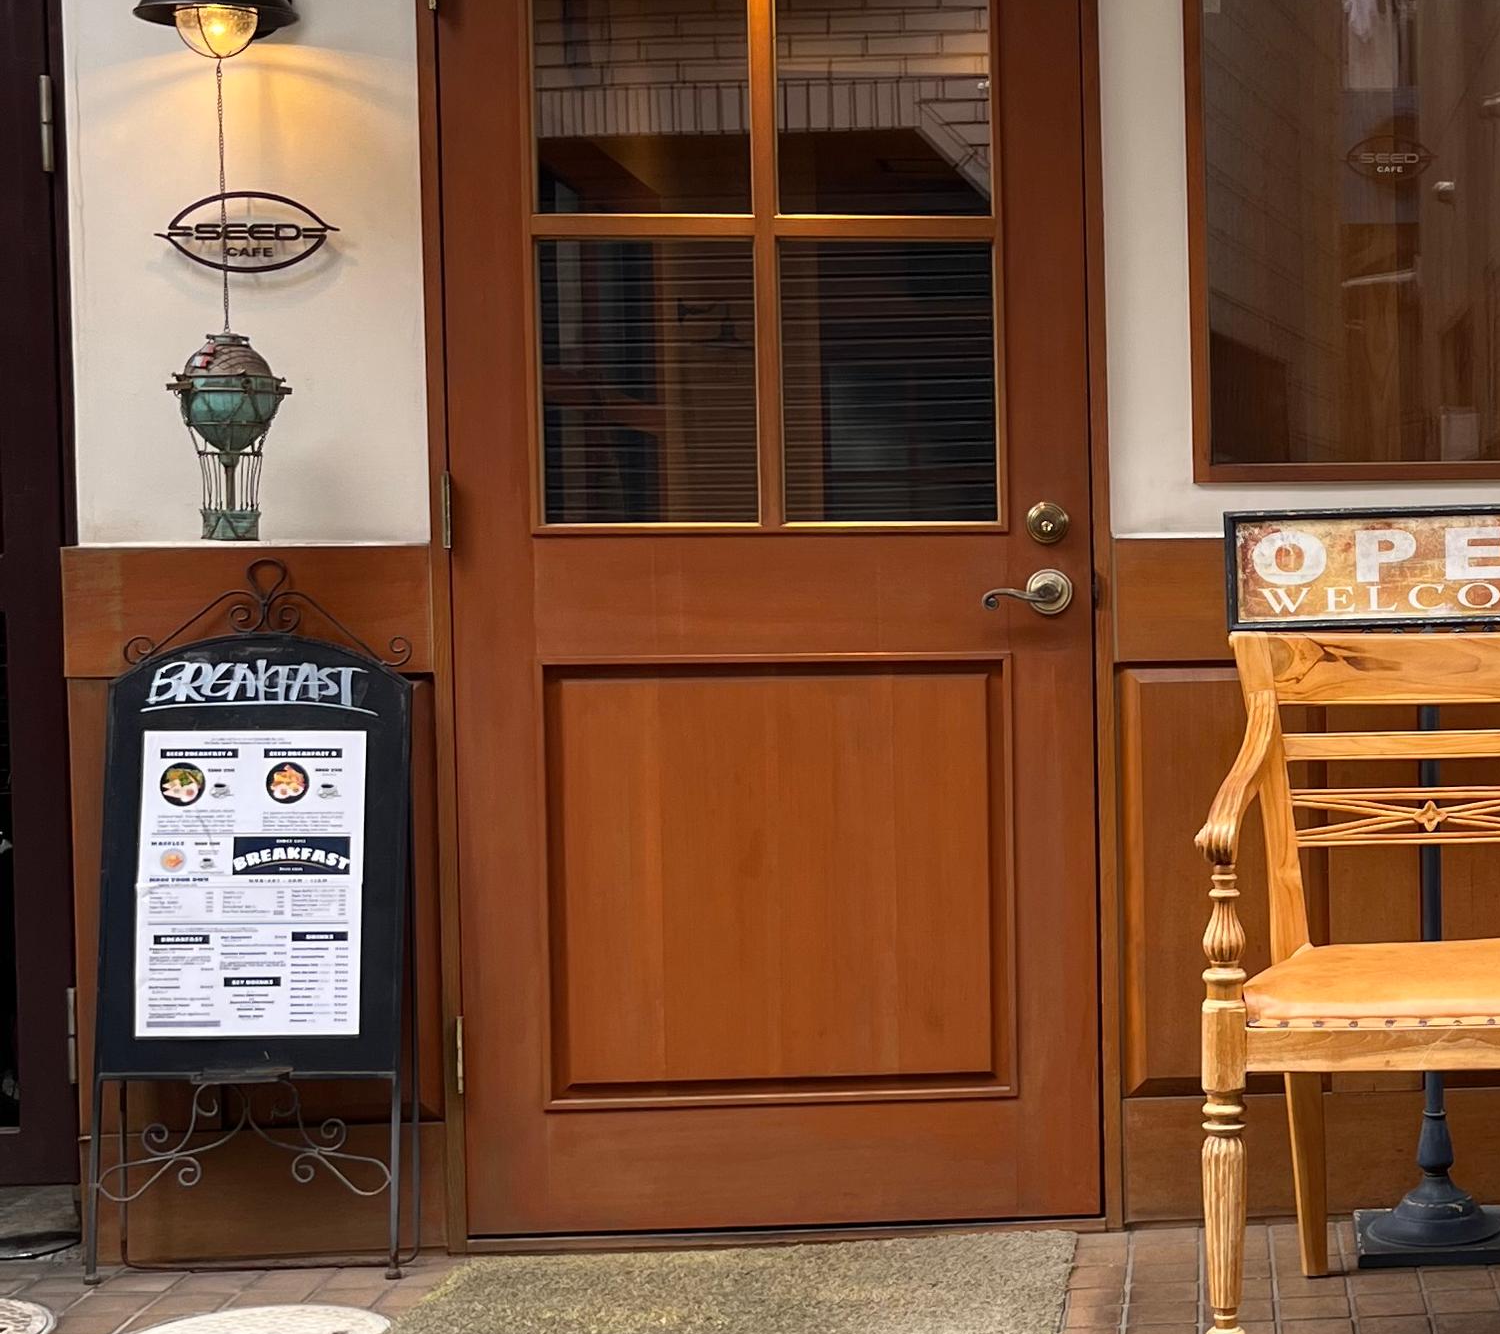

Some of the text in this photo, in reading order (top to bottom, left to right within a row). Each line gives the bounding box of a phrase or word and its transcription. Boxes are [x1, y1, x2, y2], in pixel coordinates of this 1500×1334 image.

[1360, 153, 1419, 164] SEED
[194, 223, 302, 241] SEED
[225, 247, 274, 258] CAFE
[145, 659, 370, 707] BREAKFAST
[233, 847, 351, 871] BREAKFAST
